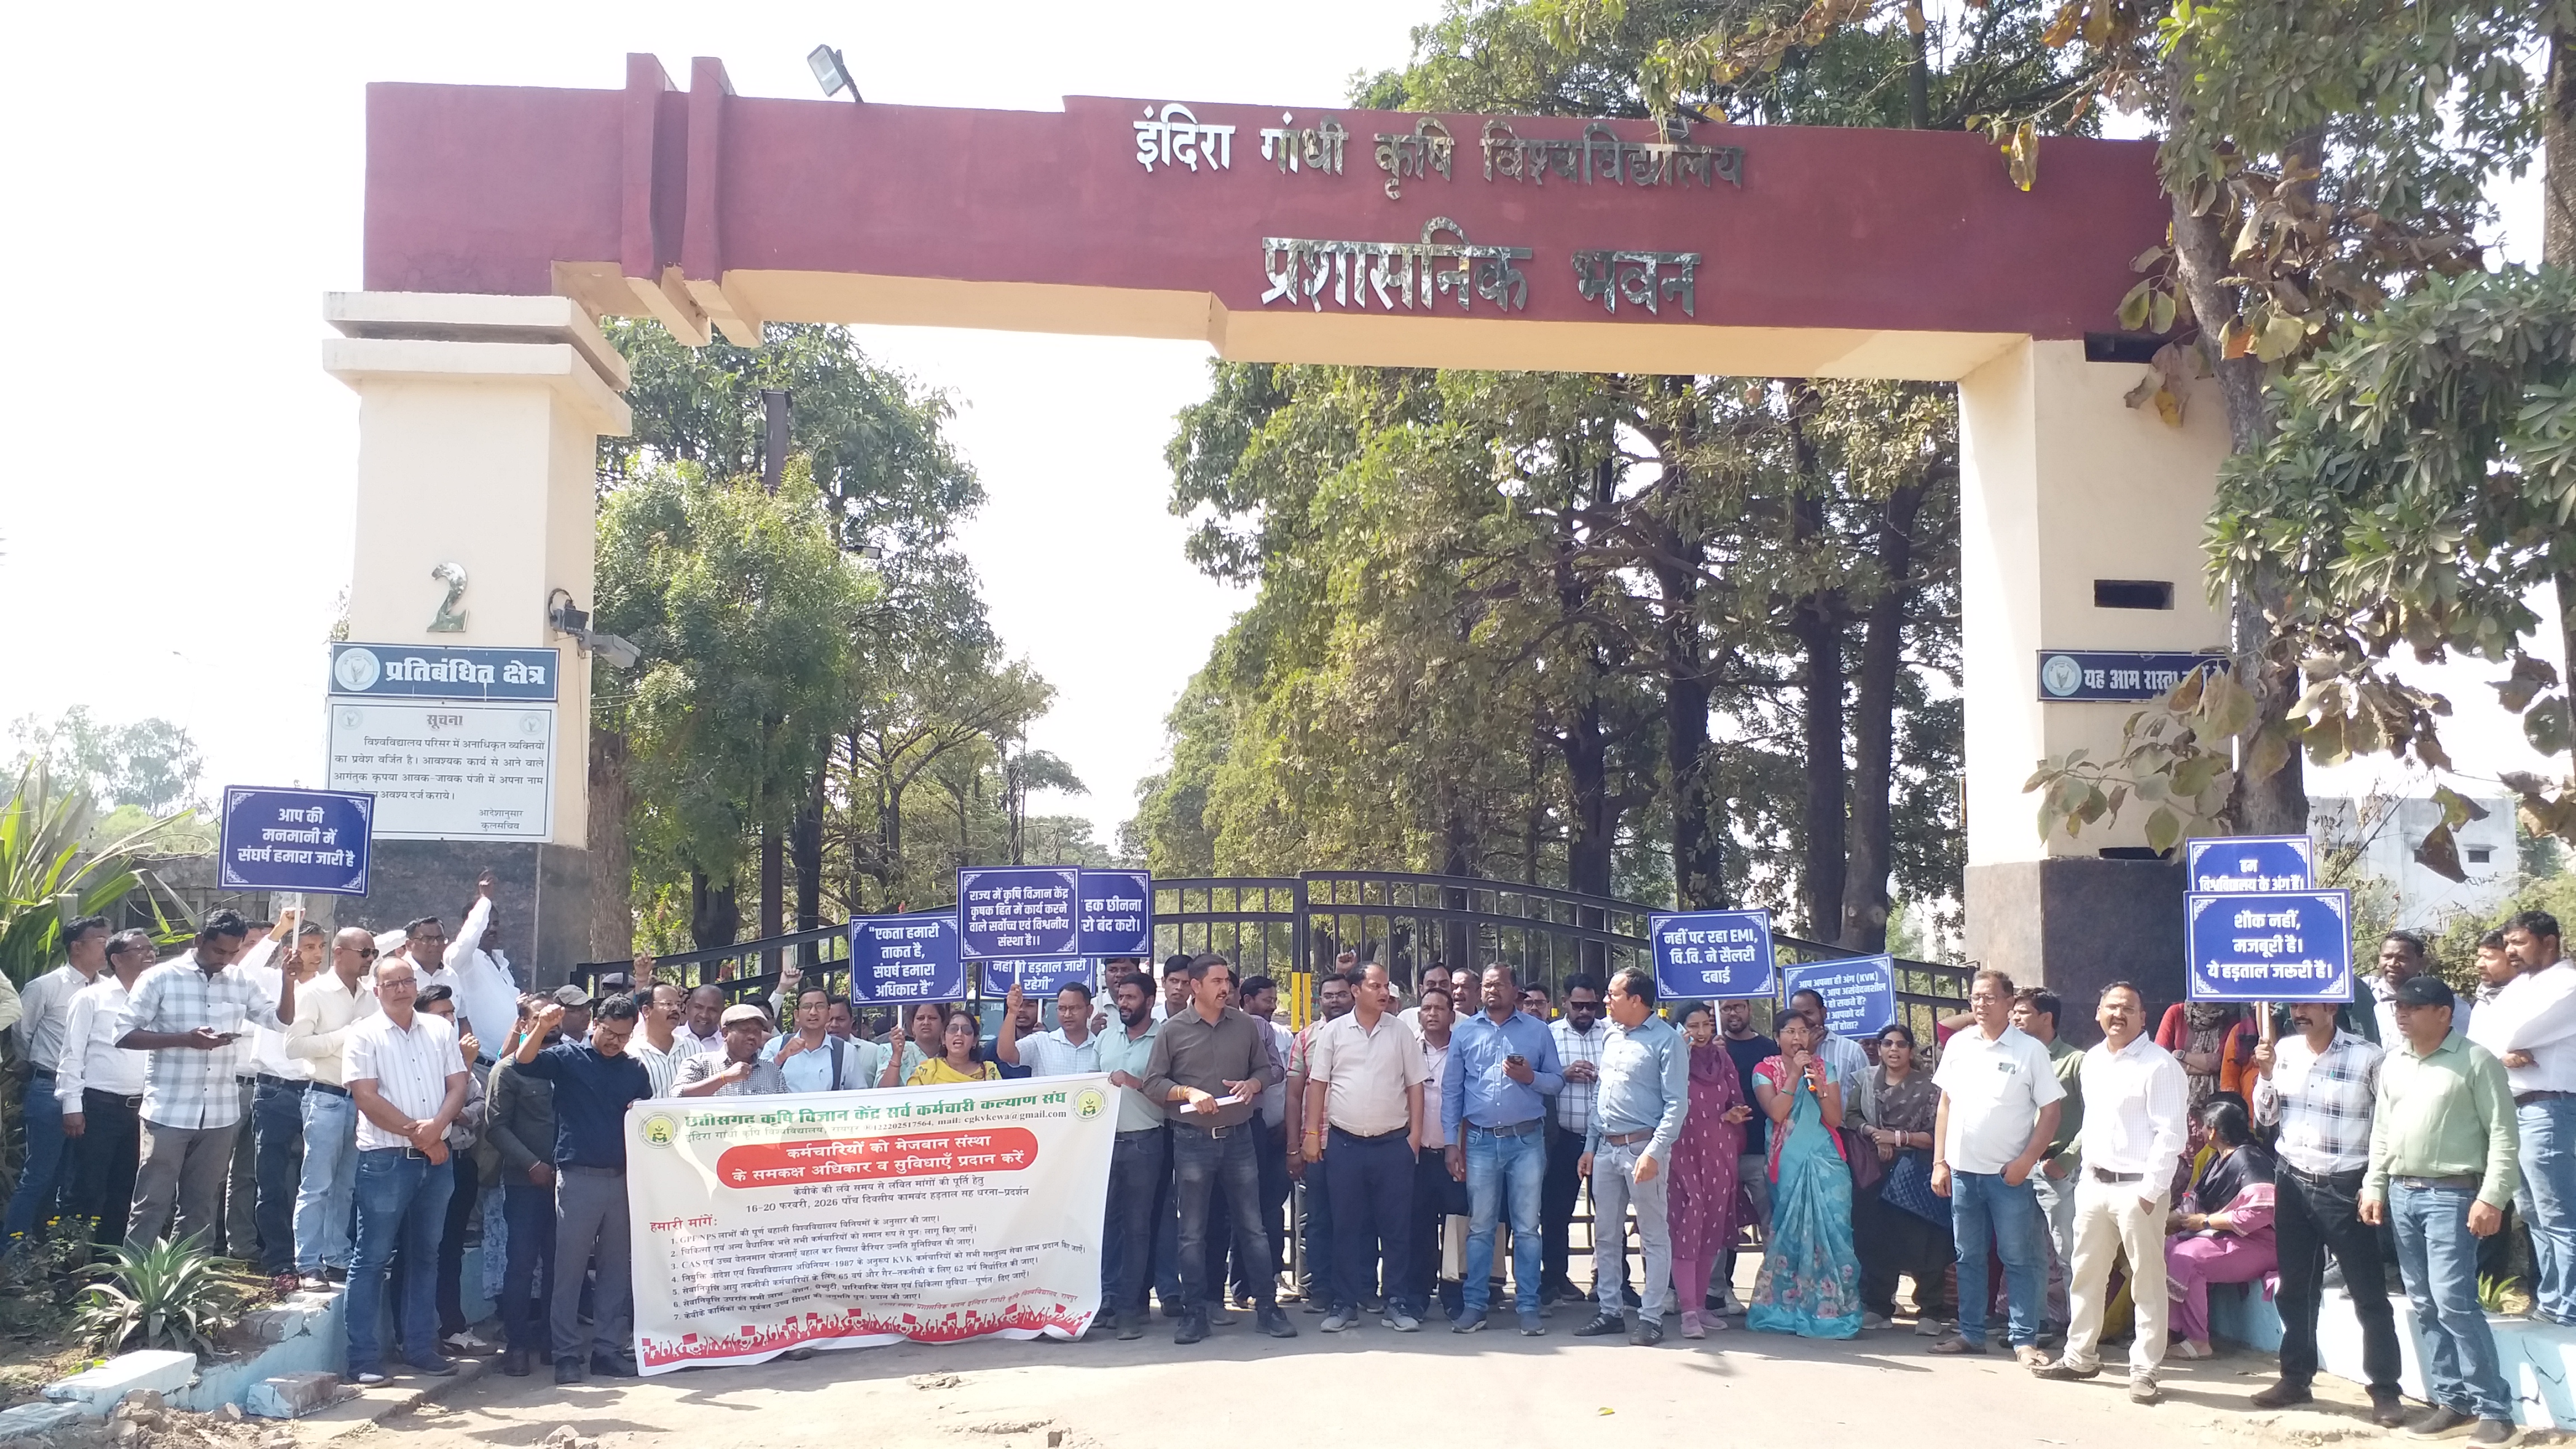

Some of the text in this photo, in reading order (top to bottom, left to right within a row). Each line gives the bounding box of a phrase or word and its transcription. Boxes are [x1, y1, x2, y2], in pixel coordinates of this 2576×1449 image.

[1134, 103, 1745, 200] इंदिरा गांधी कृषि विश्वविद्यालय
[1261, 215, 1701, 317] प्रशासनिक भवन
[427, 562, 470, 632] 2
[386, 657, 495, 684] प्रतिबंधित
[503, 661, 546, 685] क्षेत्र
[2083, 670, 2105, 688] यह
[2109, 670, 2140, 690] आम
[427, 714, 463, 729] सूचना
[364, 736, 422, 747] विश्वविद्यालय
[424, 737, 451, 747] परिसर
[463, 738, 506, 751] अनाधिकृत
[509, 740, 545, 750] व्यक्तियों
[352, 754, 373, 763] प्रवेश
[378, 754, 402, 764] वर्जित
[423, 756, 463, 765] आवश्यक
[466, 756, 486, 765] कार्य
[491, 756, 499, 766] से
[504, 757, 521, 766] आने
[525, 757, 544, 767] वाले
[334, 771, 368, 783] आगंतुक
[372, 774, 398, 783] कृपया
[466, 773, 484, 783] पंजी
[410, 789, 424, 799] दर्ज
[278, 807, 325, 824] आप की
[479, 808, 524, 818] आदेशानुसार
[481, 821, 520, 830] कुलसचिव
[262, 827, 338, 845] मनमानी में
[238, 845, 356, 867] संघर्ष हमारा जारी है
[2239, 859, 2258, 872] हम
[2258, 875, 2270, 891] के
[2272, 876, 2290, 891] अंग
[969, 886, 1069, 904] राज्य में कृषि विज्ञान केंद्र
[970, 901, 1068, 921] कृषक हित में कार्य करने
[1106, 895, 1142, 912] छीनना
[969, 919, 987, 932] वाले
[988, 917, 1017, 932] सर्वोच्च
[1019, 917, 1032, 930] एवं
[1096, 916, 1113, 932] बंद
[1114, 915, 1140, 932] करो।
[2234, 910, 2301, 930] शौक नहीं,
[906, 922, 940, 939] हमारी
[1663, 929, 1758, 945] नहीं पट रहा EMI,
[997, 934, 1024, 947] संस्था
[2232, 935, 2302, 958] मजबूरी है।
[880, 941, 925, 959] ताकत है,
[1669, 948, 1755, 965] वि.वि. ने सैलरी
[873, 962, 936, 978] संघर्ष हमारा
[1027, 962, 1063, 976] हड़ताल
[1063, 958, 1087, 972] जारी
[2206, 960, 2332, 982] ये हड़ताल जरूरी है।
[1701, 968, 1731, 984] दबाई
[1798, 971, 1878, 988] आप अपना ही अंग (KVK)
[875, 981, 918, 997] अधिकार
[1827, 988, 1841, 997] आप
[1842, 982, 1886, 995] असंवेदनशील
[1829, 998, 1836, 1008] हो
[1837, 997, 1856, 1007] सकते
[1831, 1009, 1854, 1019] आपको
[1855, 1008, 1865, 1017] दर्द
[1840, 1021, 1858, 1030] होता?
[761, 1110, 793, 1128] कृषि
[799, 1108, 849, 1123] विज्ञान
[854, 1105, 880, 1120] केंद्र
[887, 1102, 910, 1118] सर्व
[916, 1098, 975, 1116] कर्मचारी
[981, 1096, 1036, 1109] कल्याण
[1042, 1090, 1067, 1104] संघ
[786, 1139, 864, 1159] कर्मचारियों
[870, 1138, 889, 1153] को
[954, 1134, 991, 1148] संस्था
[732, 1150, 1024, 1182] के समकक्ष अधिकार व सुविधाएँ प्रदान करें
[854, 1175, 984, 1191] समय पूर्ति हेतु
[862, 1193, 894, 1203] दिवसीय
[930, 1190, 958, 1201] हड़ताल
[650, 1217, 683, 1233] हमारी
[792, 1222, 837, 1232] विश्वविद्यालय
[811, 1233, 847, 1242] कर्मचारियों
